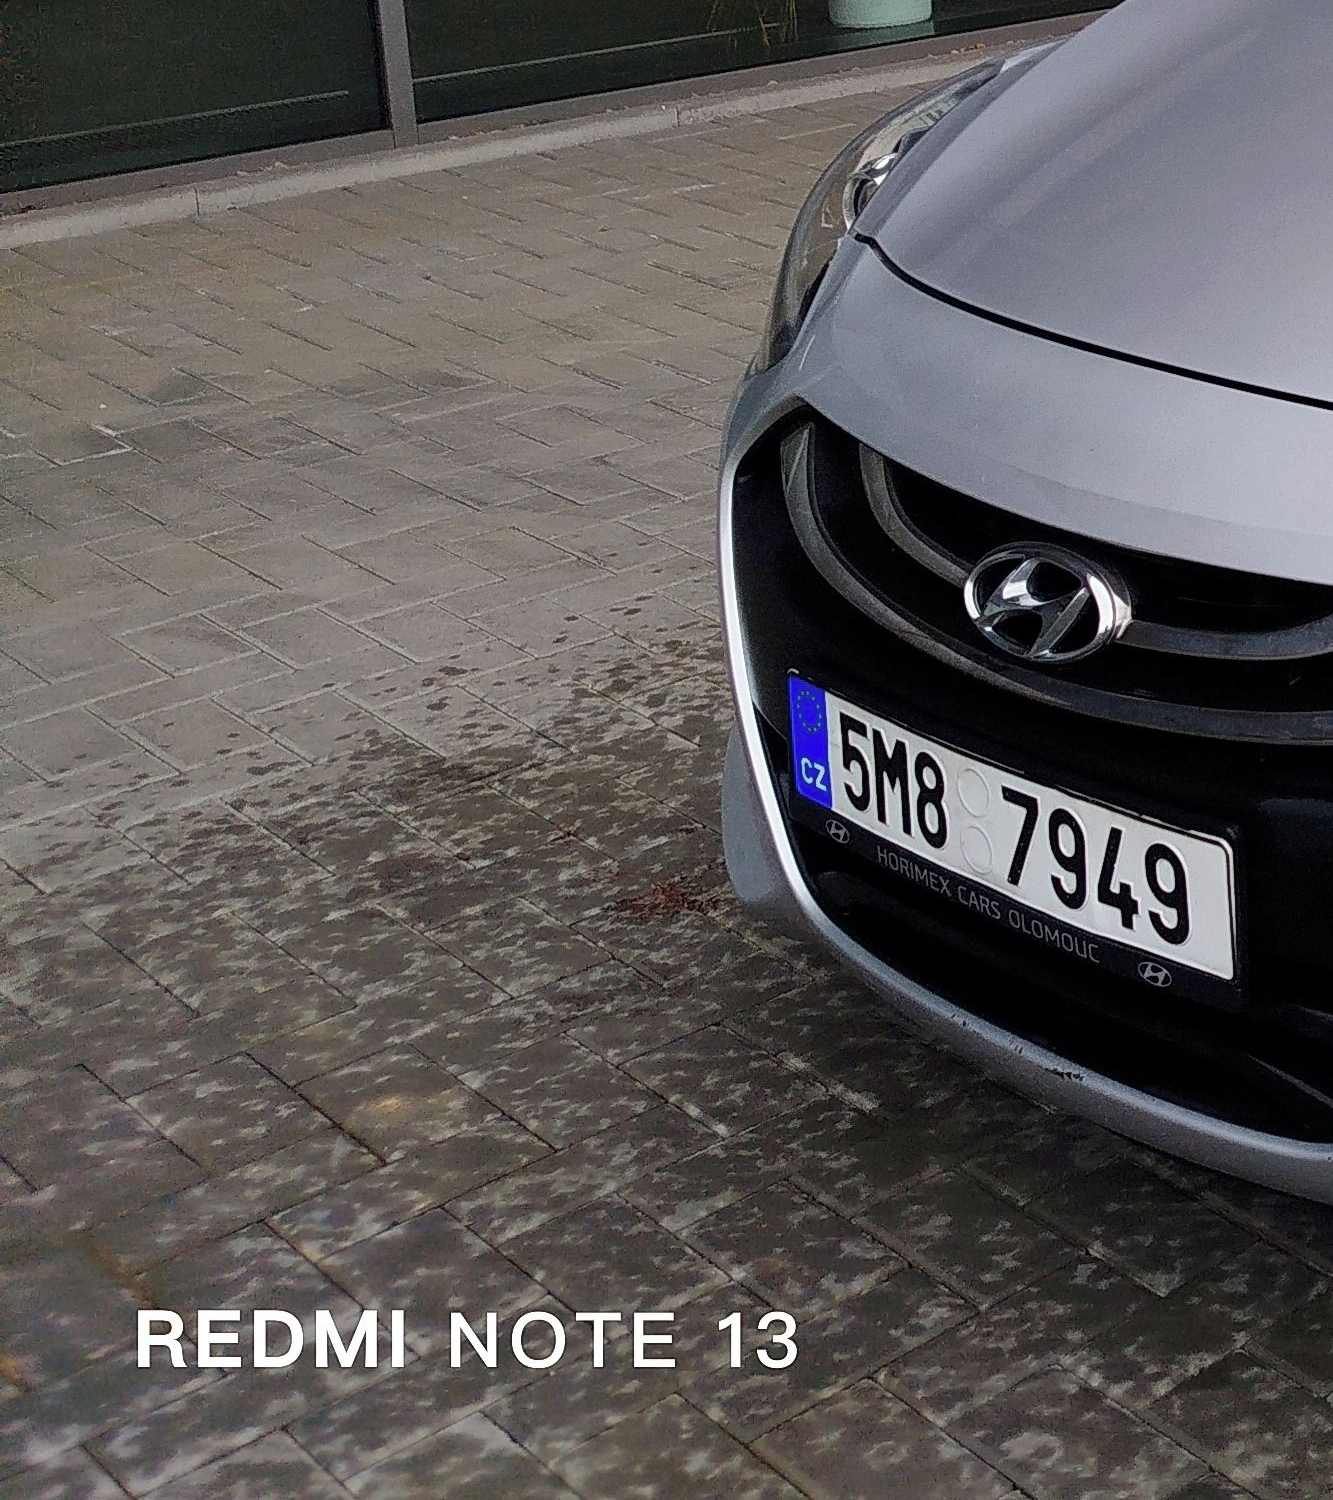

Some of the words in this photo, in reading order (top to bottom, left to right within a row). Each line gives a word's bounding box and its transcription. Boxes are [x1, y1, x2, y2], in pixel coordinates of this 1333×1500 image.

[800, 757, 827, 792] CZ
[839, 711, 949, 851] 5M8
[1001, 785, 1190, 945] 7949
[876, 845, 953, 898] HORIMEX
[957, 886, 1002, 920] CARS
[1008, 909, 1101, 964] OLOMOUC
